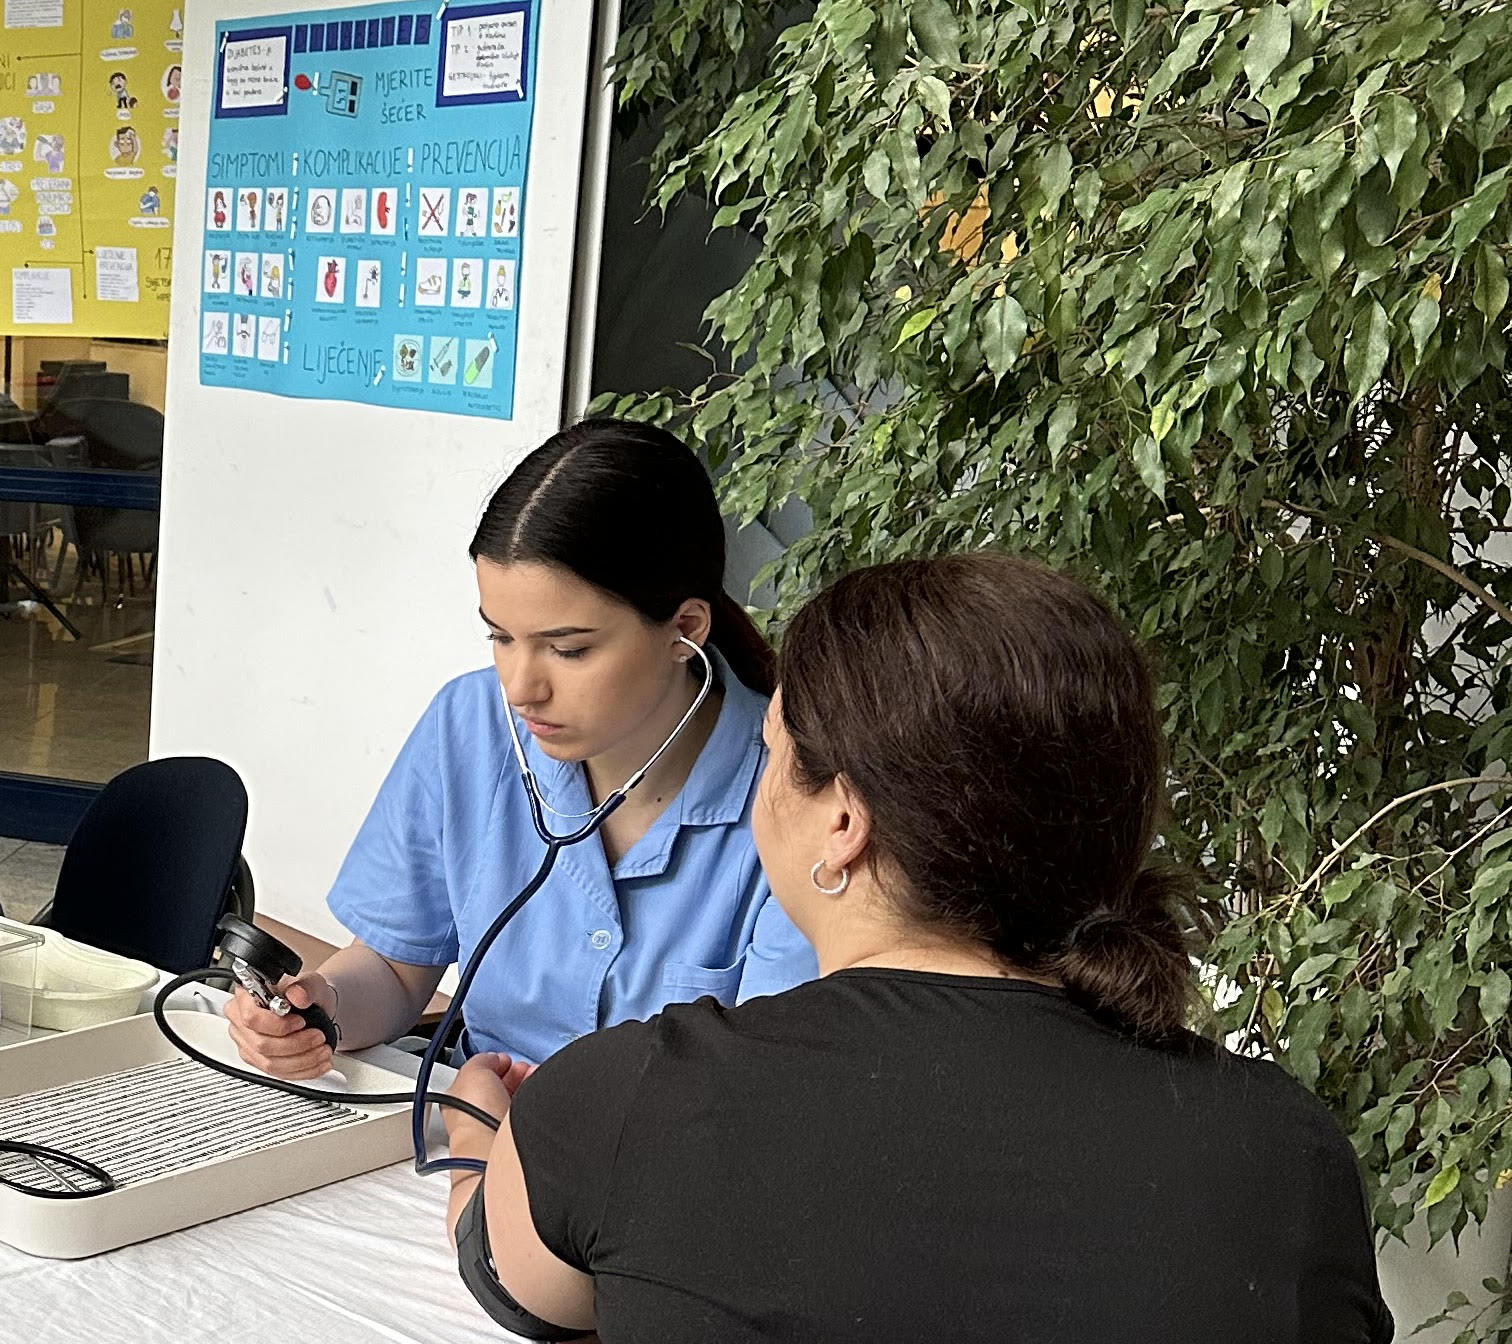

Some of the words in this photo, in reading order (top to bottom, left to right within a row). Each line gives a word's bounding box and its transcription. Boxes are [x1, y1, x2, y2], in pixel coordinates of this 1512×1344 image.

[375, 68, 432, 97] MJERITE
[211, 152, 284, 179] SIMPTOMI
[303, 146, 402, 178] KOMPLIKACIJE
[421, 135, 521, 177] PREVENCIJA
[303, 341, 383, 387] LIJEČENJE
